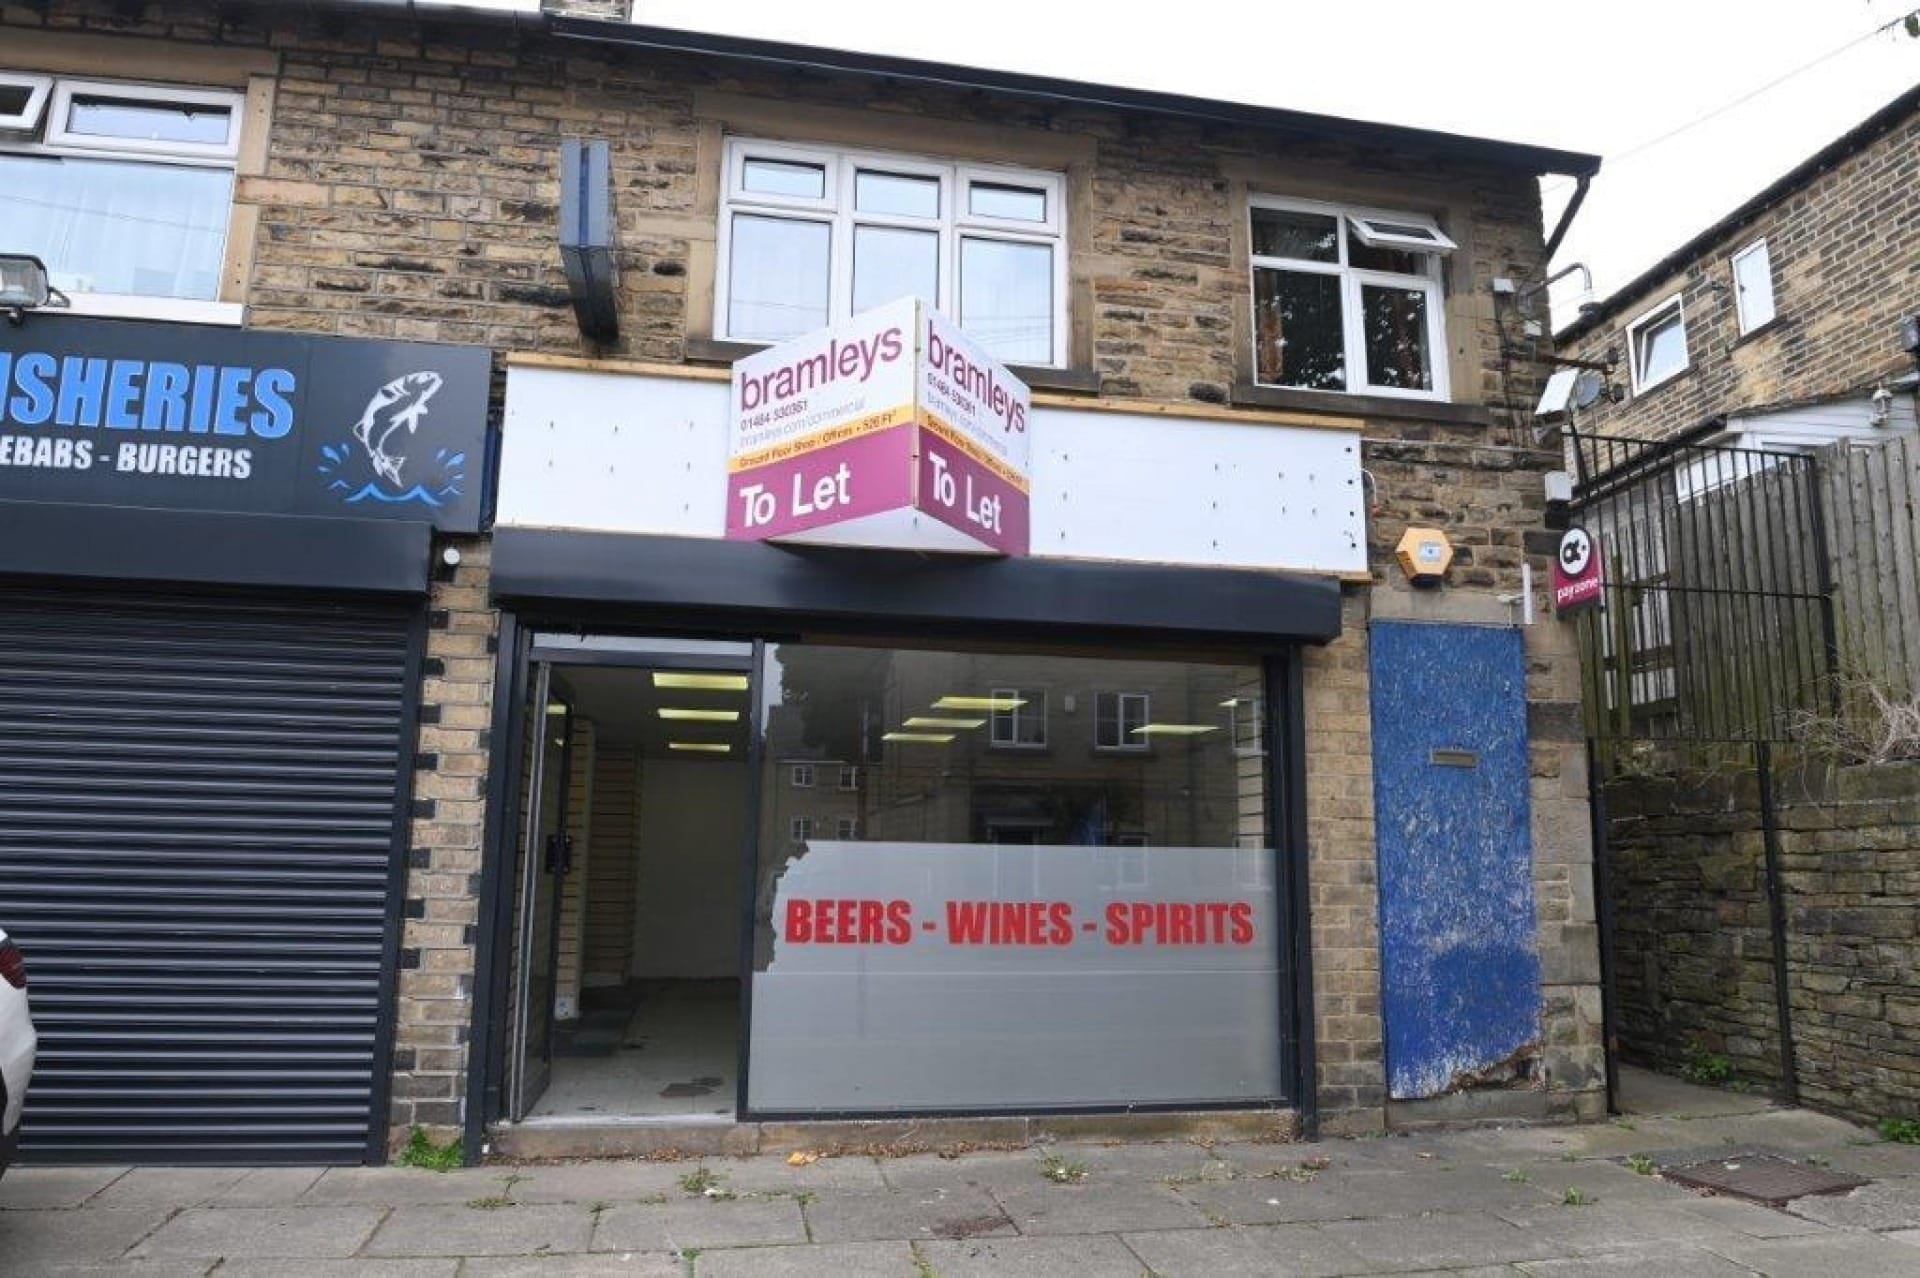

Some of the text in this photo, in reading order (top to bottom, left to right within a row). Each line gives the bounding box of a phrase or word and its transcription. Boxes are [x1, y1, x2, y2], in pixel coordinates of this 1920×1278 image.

[740, 327, 903, 412] bramleys
[927, 320, 1026, 434] bramleys
[99, 454, 110, 462] -
[116, 442, 252, 480] BURGERS
[928, 451, 1002, 535] To Let
[739, 462, 851, 528] To Let
[1557, 577, 1599, 604] payzone
[785, 899, 1253, 945] BEERS - WINES - SPIRITS
